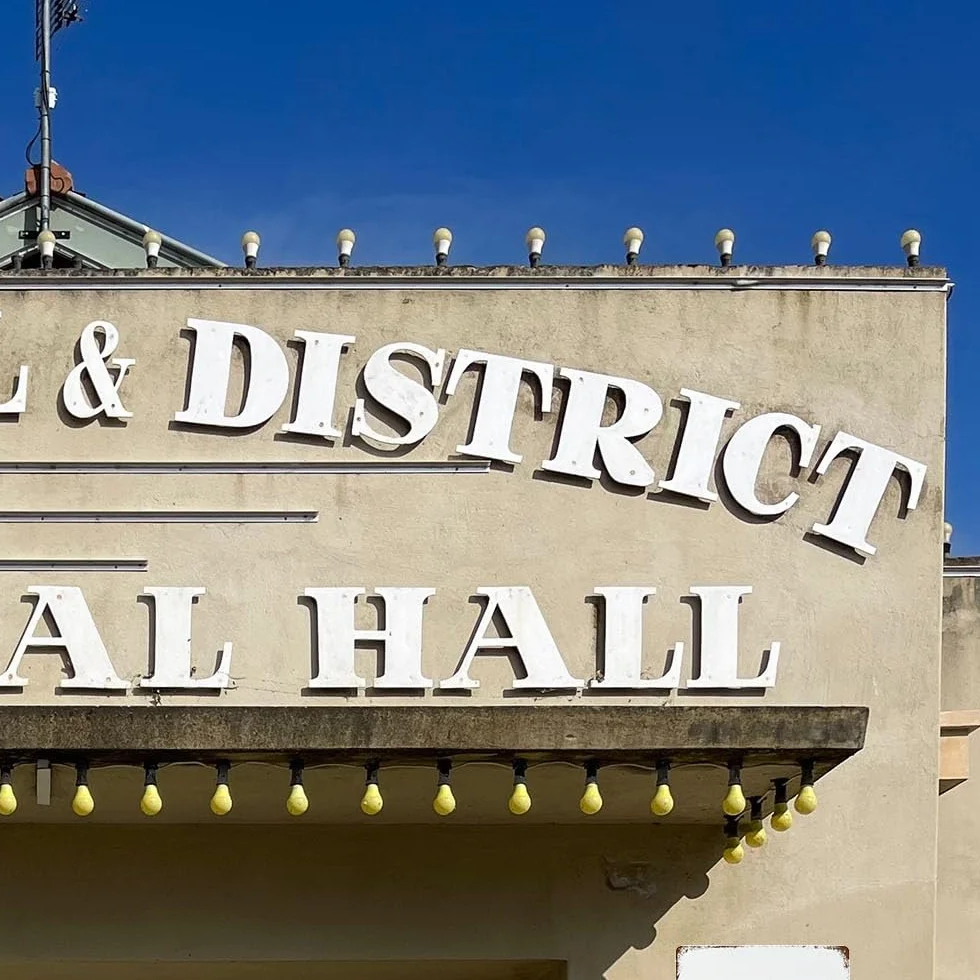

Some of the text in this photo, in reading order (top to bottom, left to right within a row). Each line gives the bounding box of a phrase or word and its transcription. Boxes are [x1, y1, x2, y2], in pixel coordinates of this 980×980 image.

[62, 319, 135, 419] &
[173, 317, 927, 556] DISTRICT
[303, 585, 781, 690] HALL
